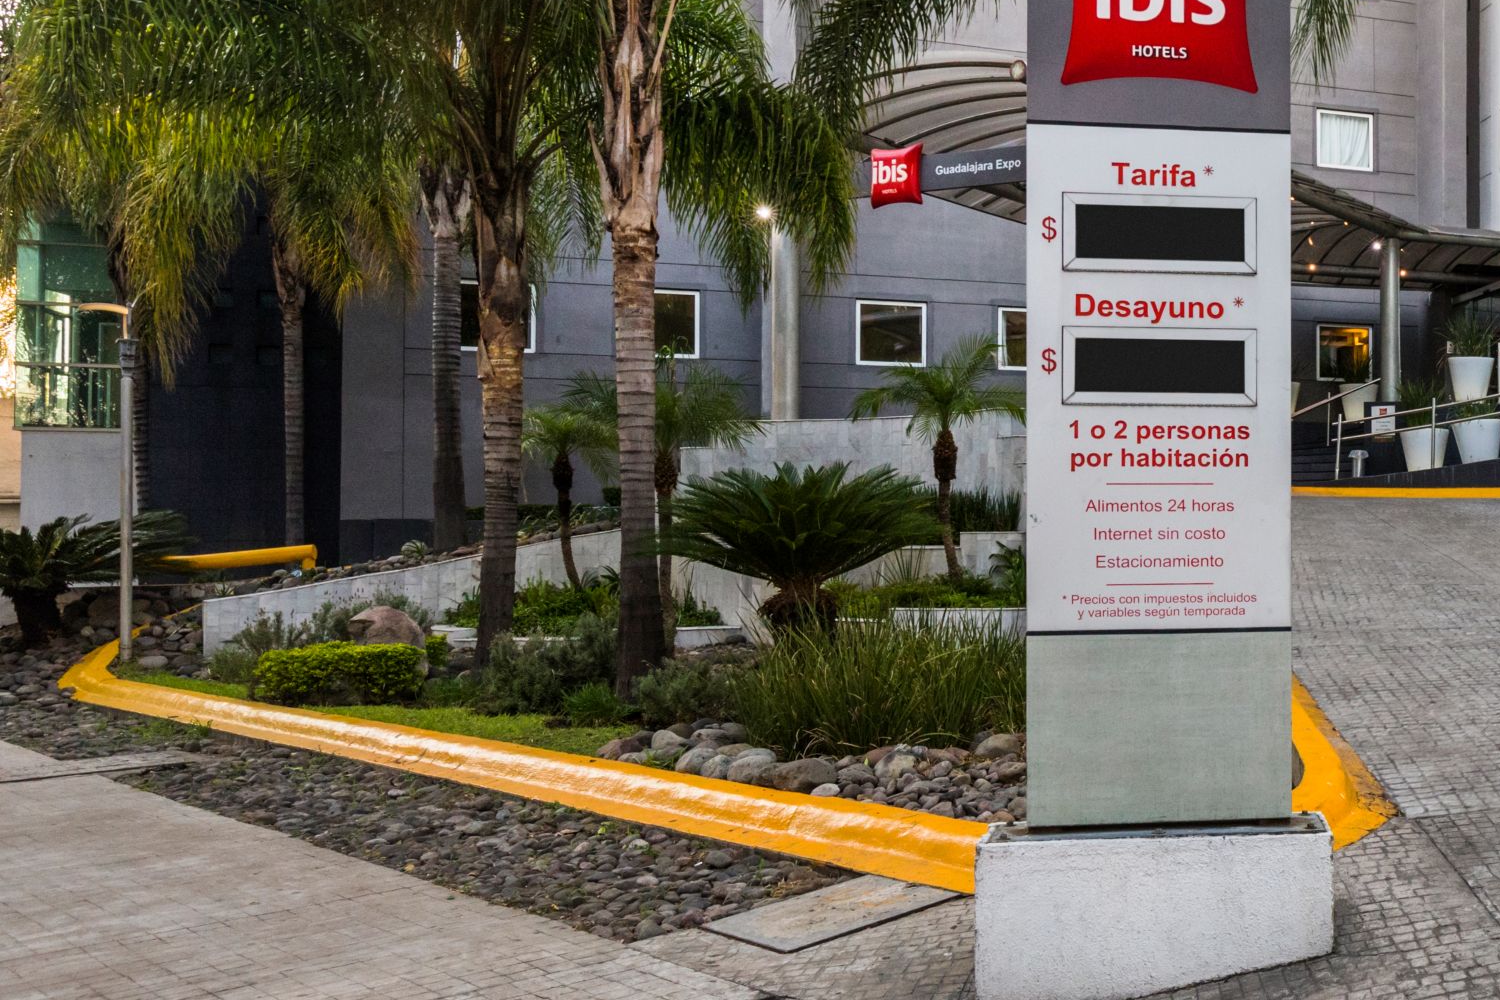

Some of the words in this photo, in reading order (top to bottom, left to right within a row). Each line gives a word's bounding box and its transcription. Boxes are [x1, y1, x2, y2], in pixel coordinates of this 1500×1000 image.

[1131, 45, 1188, 59] HOTELS
[872, 159, 908, 185] ibis
[935, 161, 994, 176] Guadalajara
[995, 158, 1022, 172] Expo
[1041, 216, 1057, 243] $
[1041, 348, 1057, 375] $
[1069, 419, 1080, 440] 1
[1090, 424, 1106, 440] o
[1113, 420, 1128, 440] 2
[1136, 423, 1251, 444] personas
[1070, 451, 1113, 472] por
[1120, 447, 1250, 468] habitación
[1085, 499, 1163, 513] Alimentos
[1167, 498, 1187, 513] 24
[1191, 498, 1235, 513] horas
[1093, 528, 1153, 541] Internet
[1157, 526, 1180, 541] sin
[1184, 526, 1226, 541] costo
[1095, 554, 1224, 569] Estacionamiento
[1071, 594, 1116, 605] Precios
[1119, 594, 1140, 605] con
[1144, 593, 1204, 607] impuestos
[1206, 592, 1257, 604] incluidos
[1077, 609, 1086, 620] y
[1088, 606, 1141, 618] variables
[1144, 605, 1181, 620] según
[1184, 605, 1246, 619] temporada
